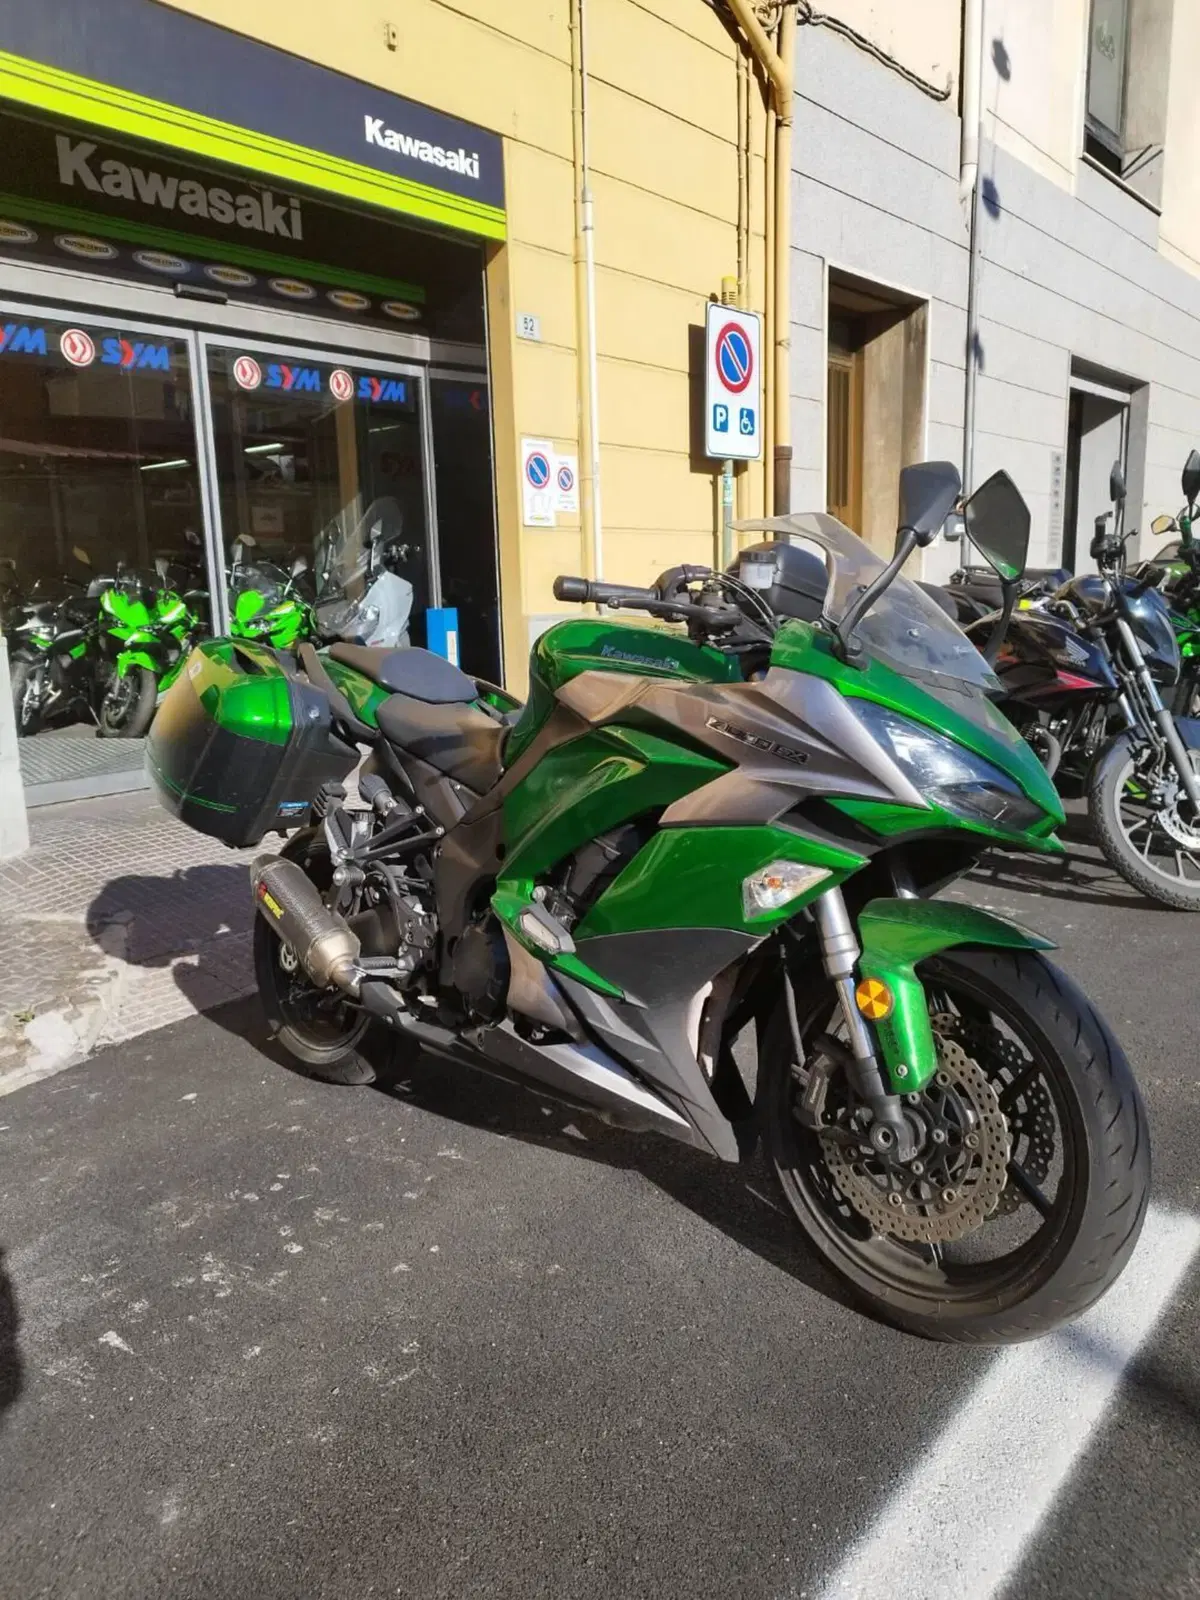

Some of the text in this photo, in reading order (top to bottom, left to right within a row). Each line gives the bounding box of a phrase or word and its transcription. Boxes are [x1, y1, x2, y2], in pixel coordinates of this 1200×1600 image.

[364, 115, 479, 178] Kawasaki
[56, 134, 303, 240] Kawasaki
[523, 316, 535, 331] 52
[0, 323, 47, 355] YM
[101, 338, 170, 371] SYM
[266, 363, 321, 392] SYM
[358, 376, 406, 403] SYM
[715, 406, 727, 429] P
